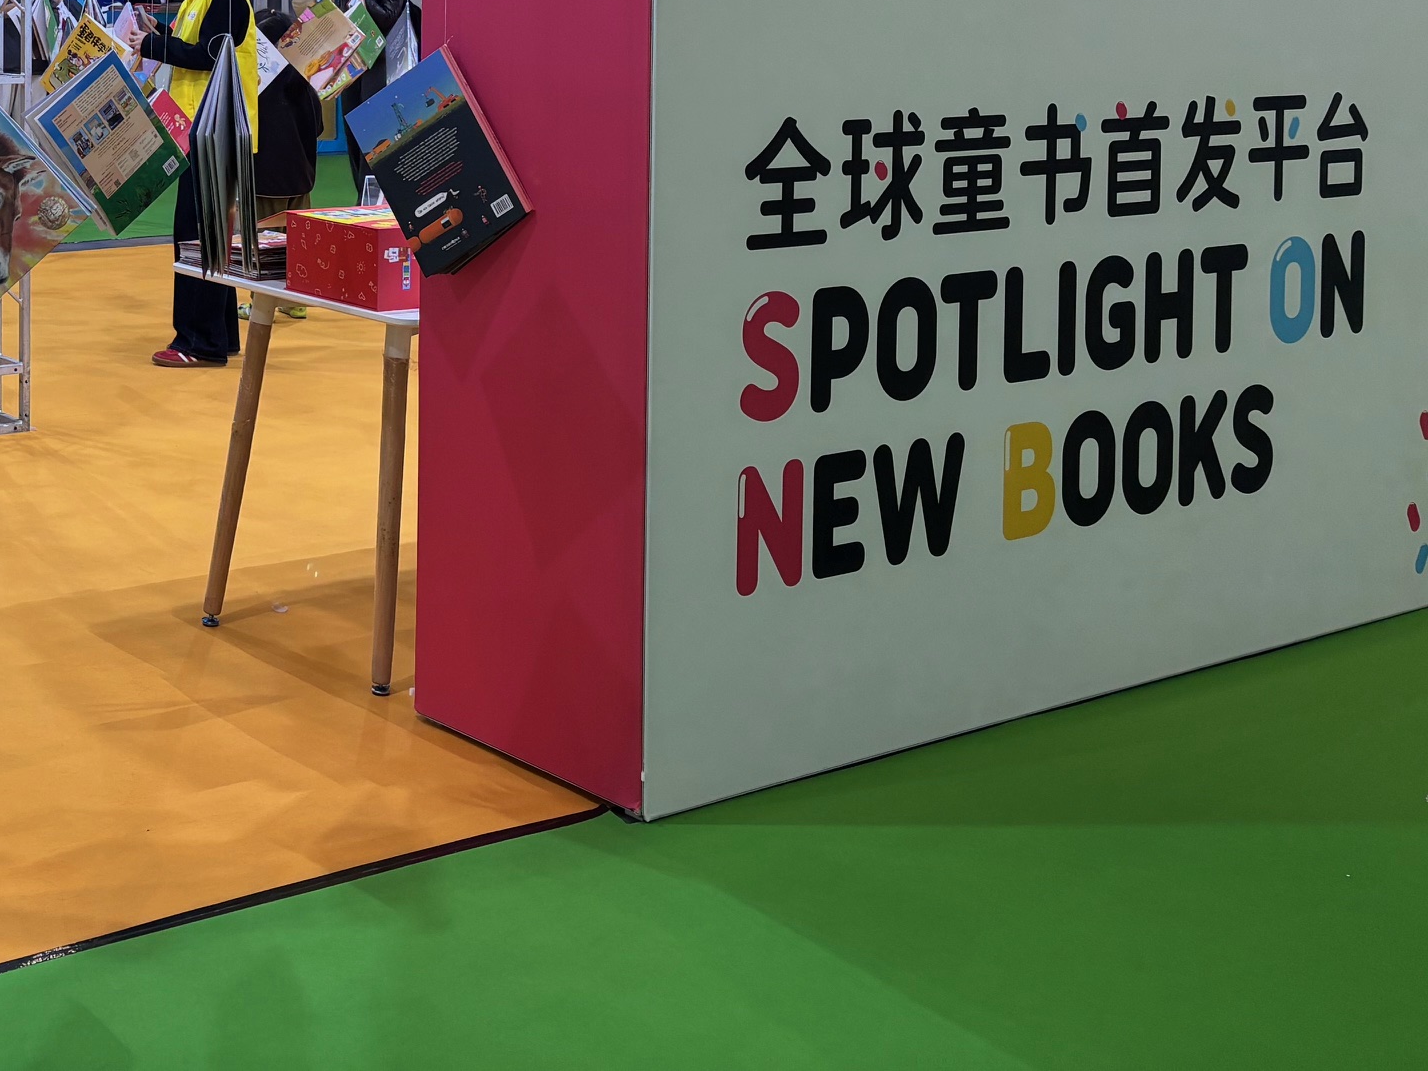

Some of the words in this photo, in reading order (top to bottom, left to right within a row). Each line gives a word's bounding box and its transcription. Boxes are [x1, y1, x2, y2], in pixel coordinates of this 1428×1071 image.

[744, 92, 1369, 251] 全球童书首发平台
[739, 243, 1249, 423] SPOTLIGHT
[1269, 229, 1367, 345] ON
[735, 431, 965, 598] NEW
[1002, 383, 1274, 542] BOOKS
